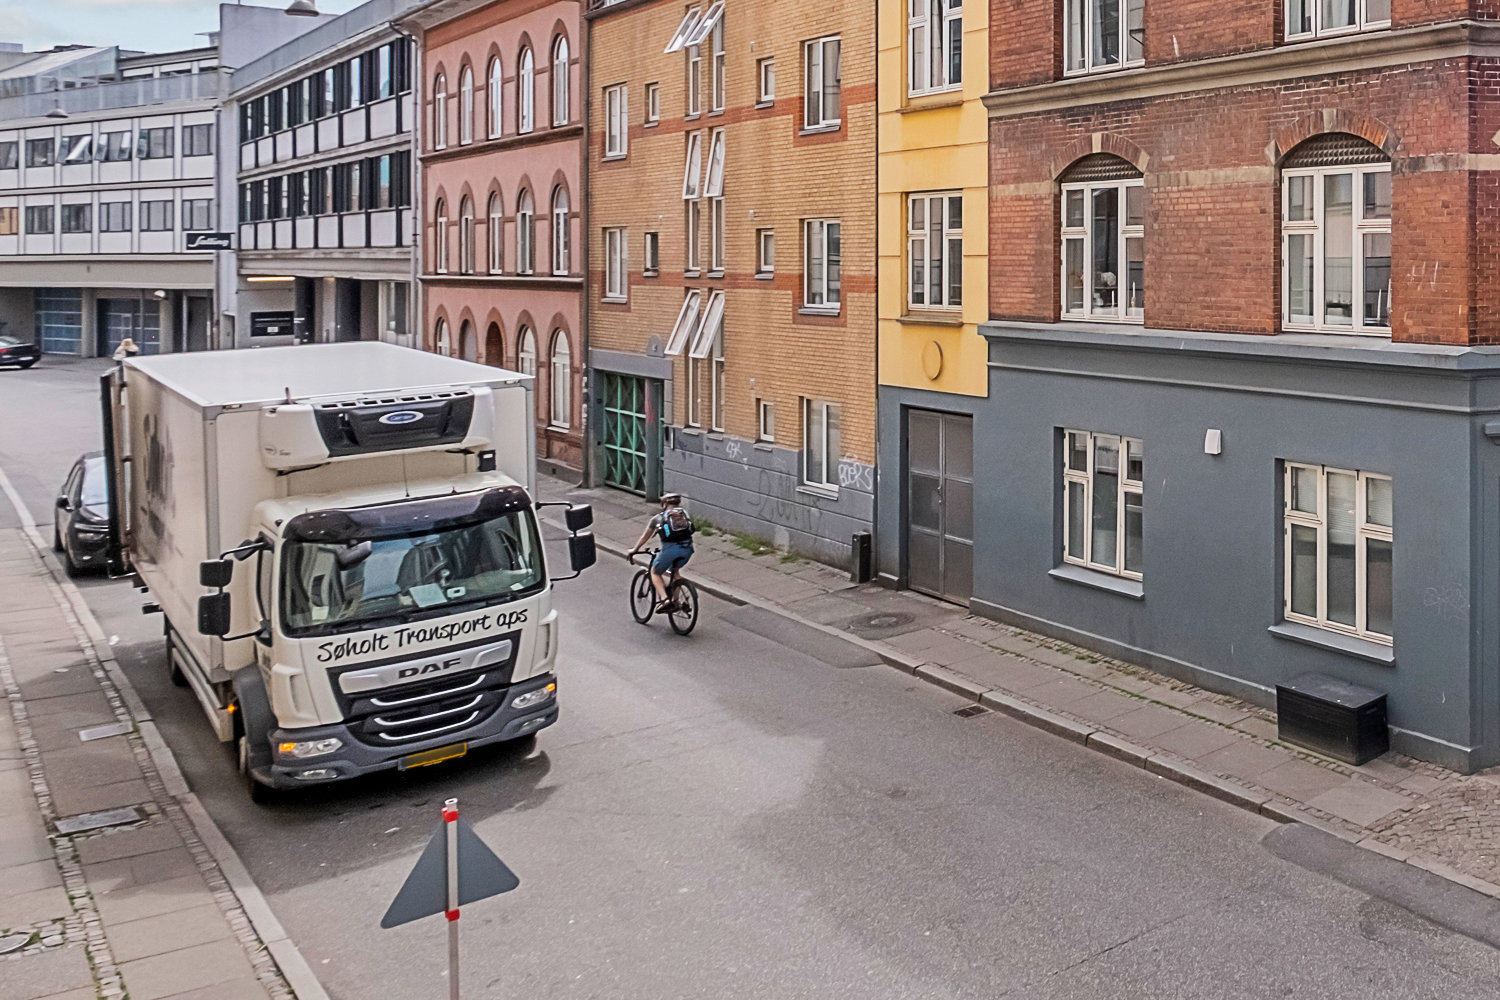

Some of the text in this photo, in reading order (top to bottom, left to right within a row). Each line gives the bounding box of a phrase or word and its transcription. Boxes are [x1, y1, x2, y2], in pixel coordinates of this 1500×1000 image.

[317, 608, 529, 662] Søholt Transport aps
[398, 657, 462, 679] DAF
